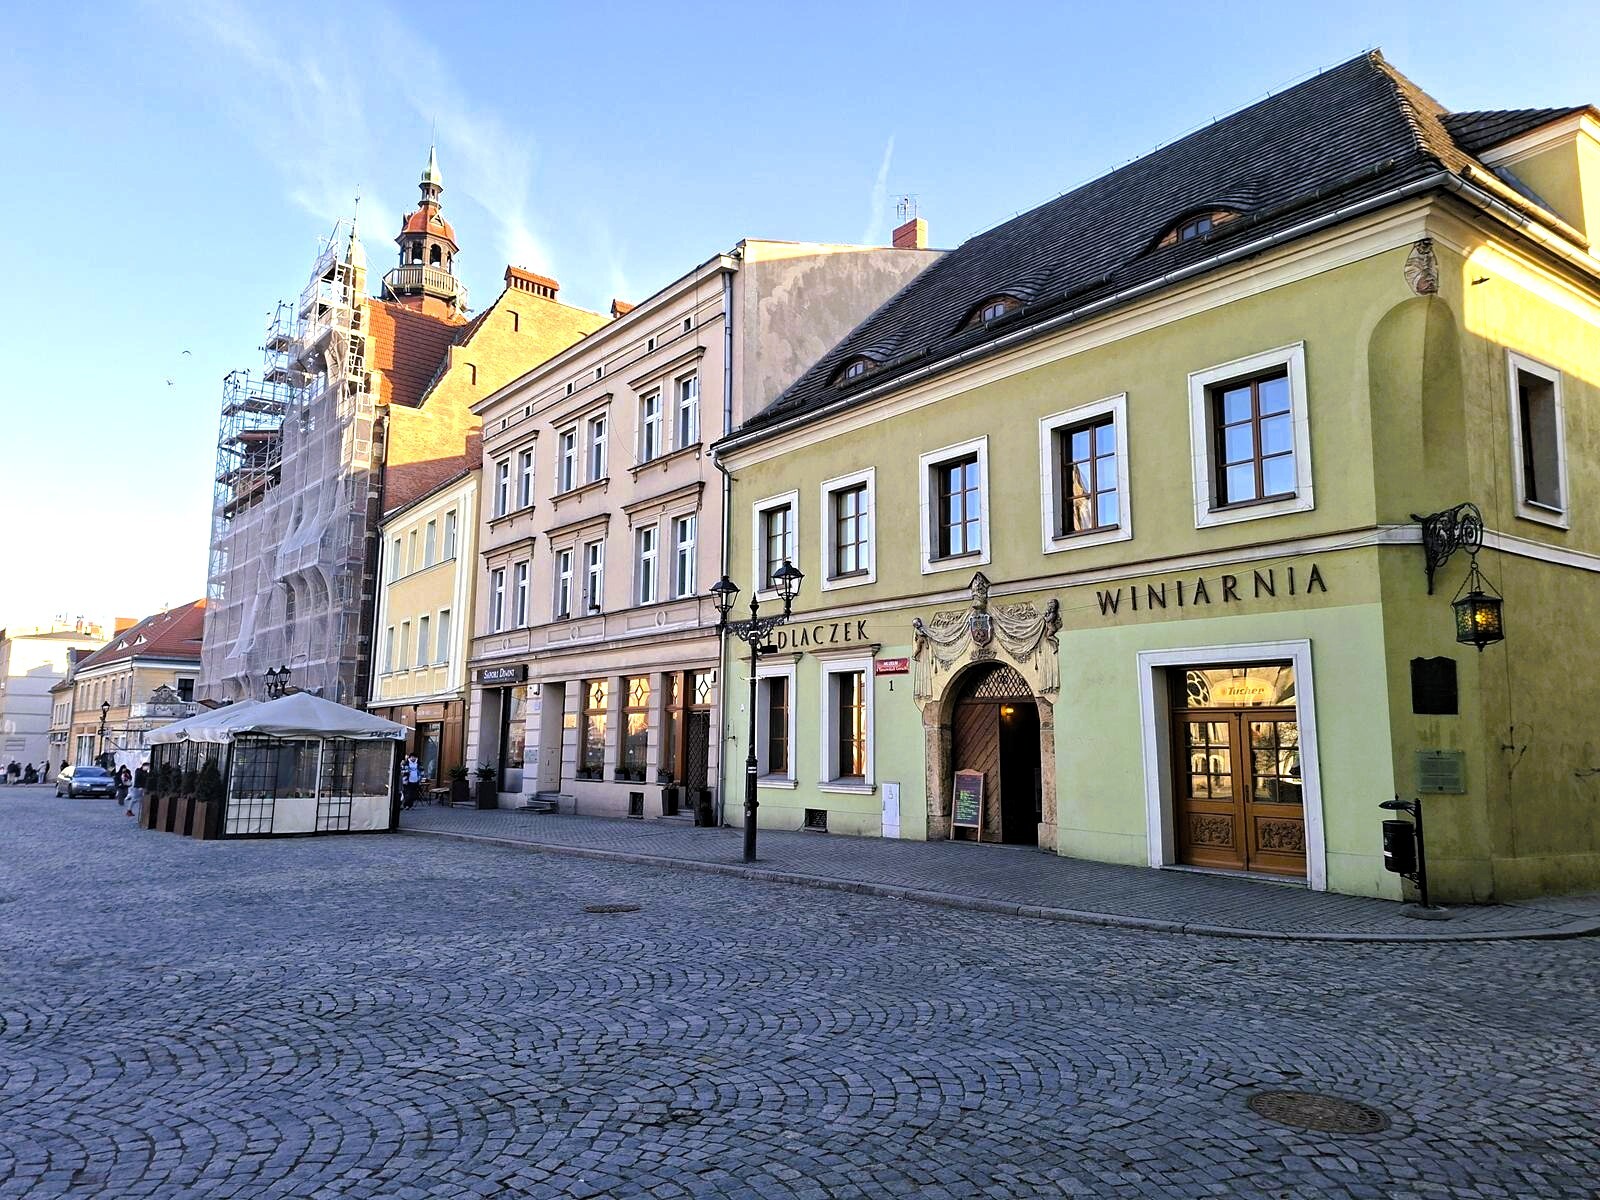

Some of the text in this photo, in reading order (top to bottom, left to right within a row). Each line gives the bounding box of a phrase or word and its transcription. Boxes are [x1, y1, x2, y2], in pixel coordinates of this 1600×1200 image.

[1096, 563, 1327, 616] WINIARNIA
[766, 620, 869, 649] EDLACZEK
[889, 680, 894, 691] 1
